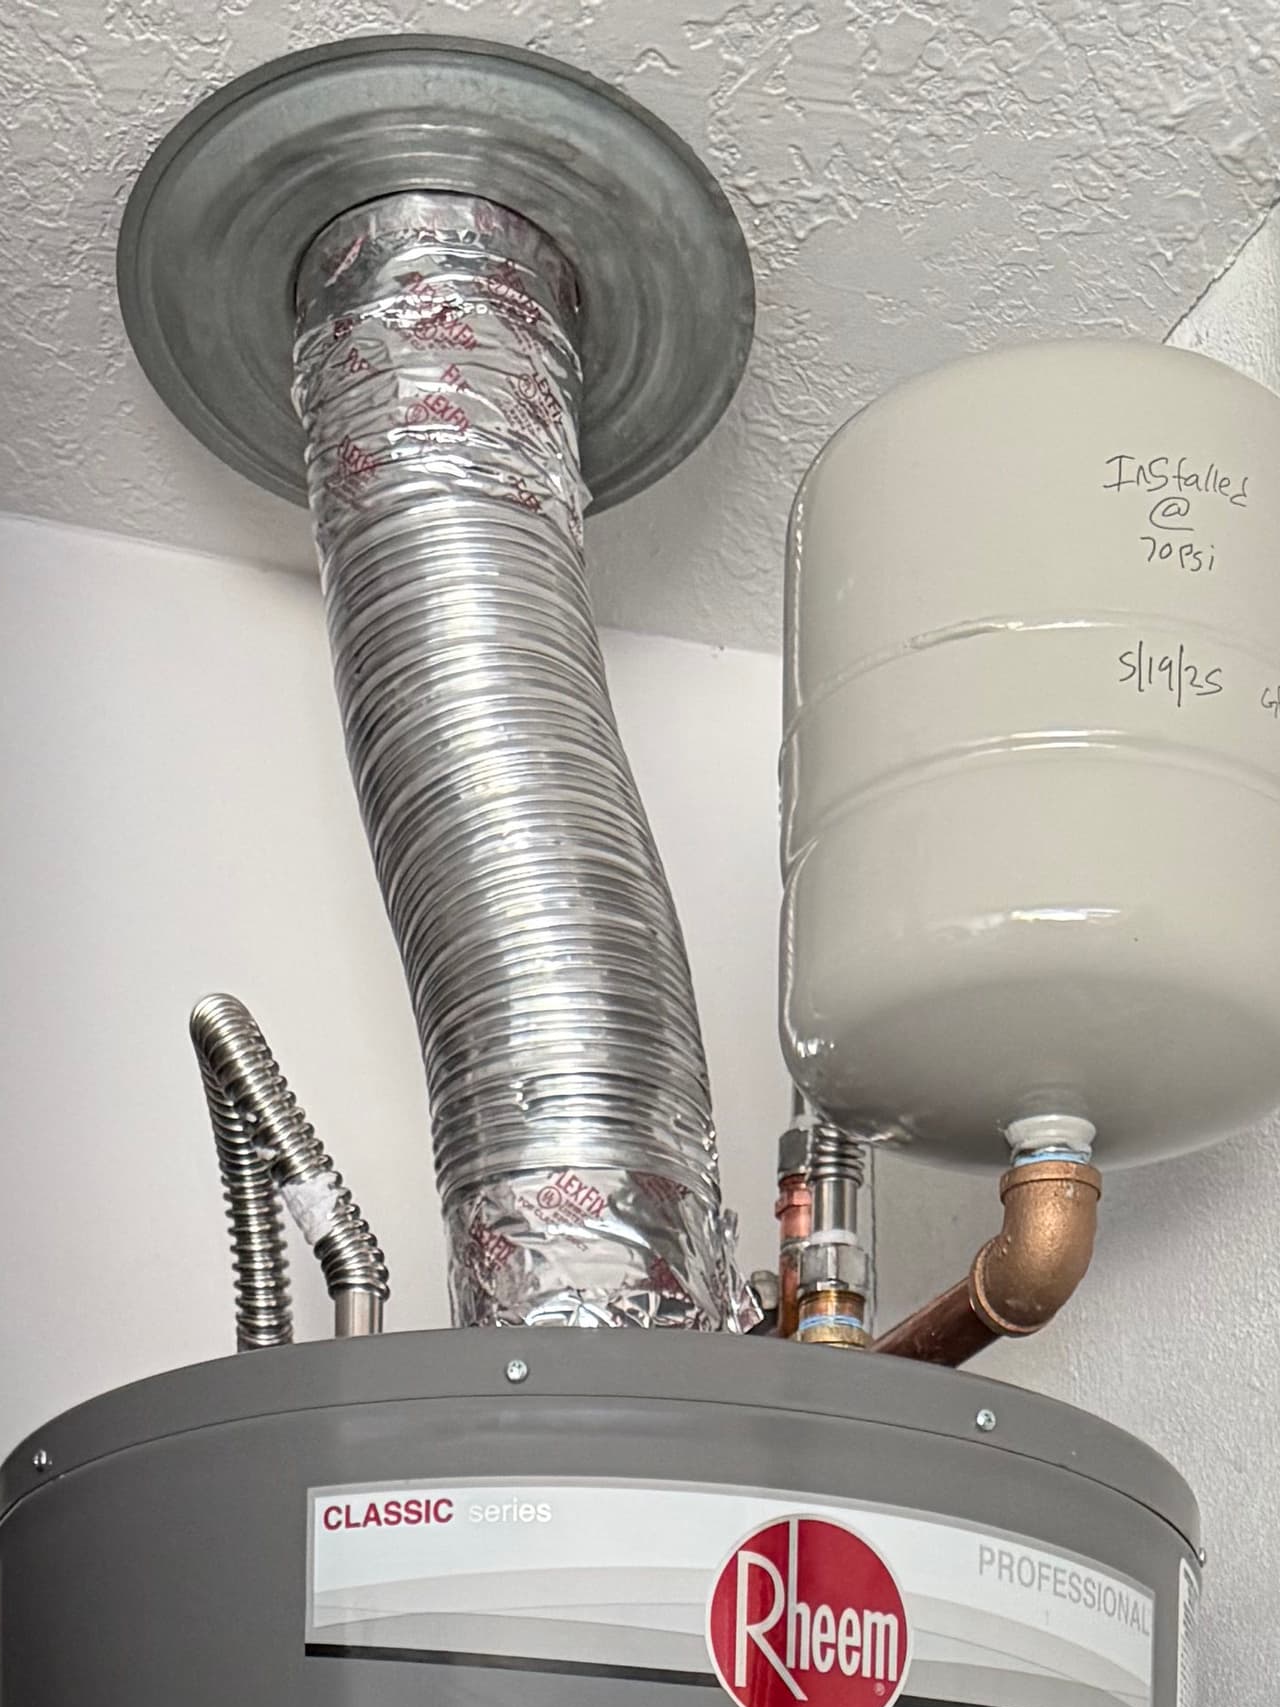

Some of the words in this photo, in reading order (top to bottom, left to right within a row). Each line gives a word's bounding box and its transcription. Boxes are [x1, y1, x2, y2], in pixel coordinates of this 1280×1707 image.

[1149, 497, 1194, 531] @
[1119, 641, 1222, 707] 5/19/25
[322, 1498, 454, 1531] CLASSIC
[468, 1498, 552, 1524] series
[736, 1518, 898, 1702] Rheem
[979, 1545, 1150, 1637] PROFESSIONAL
